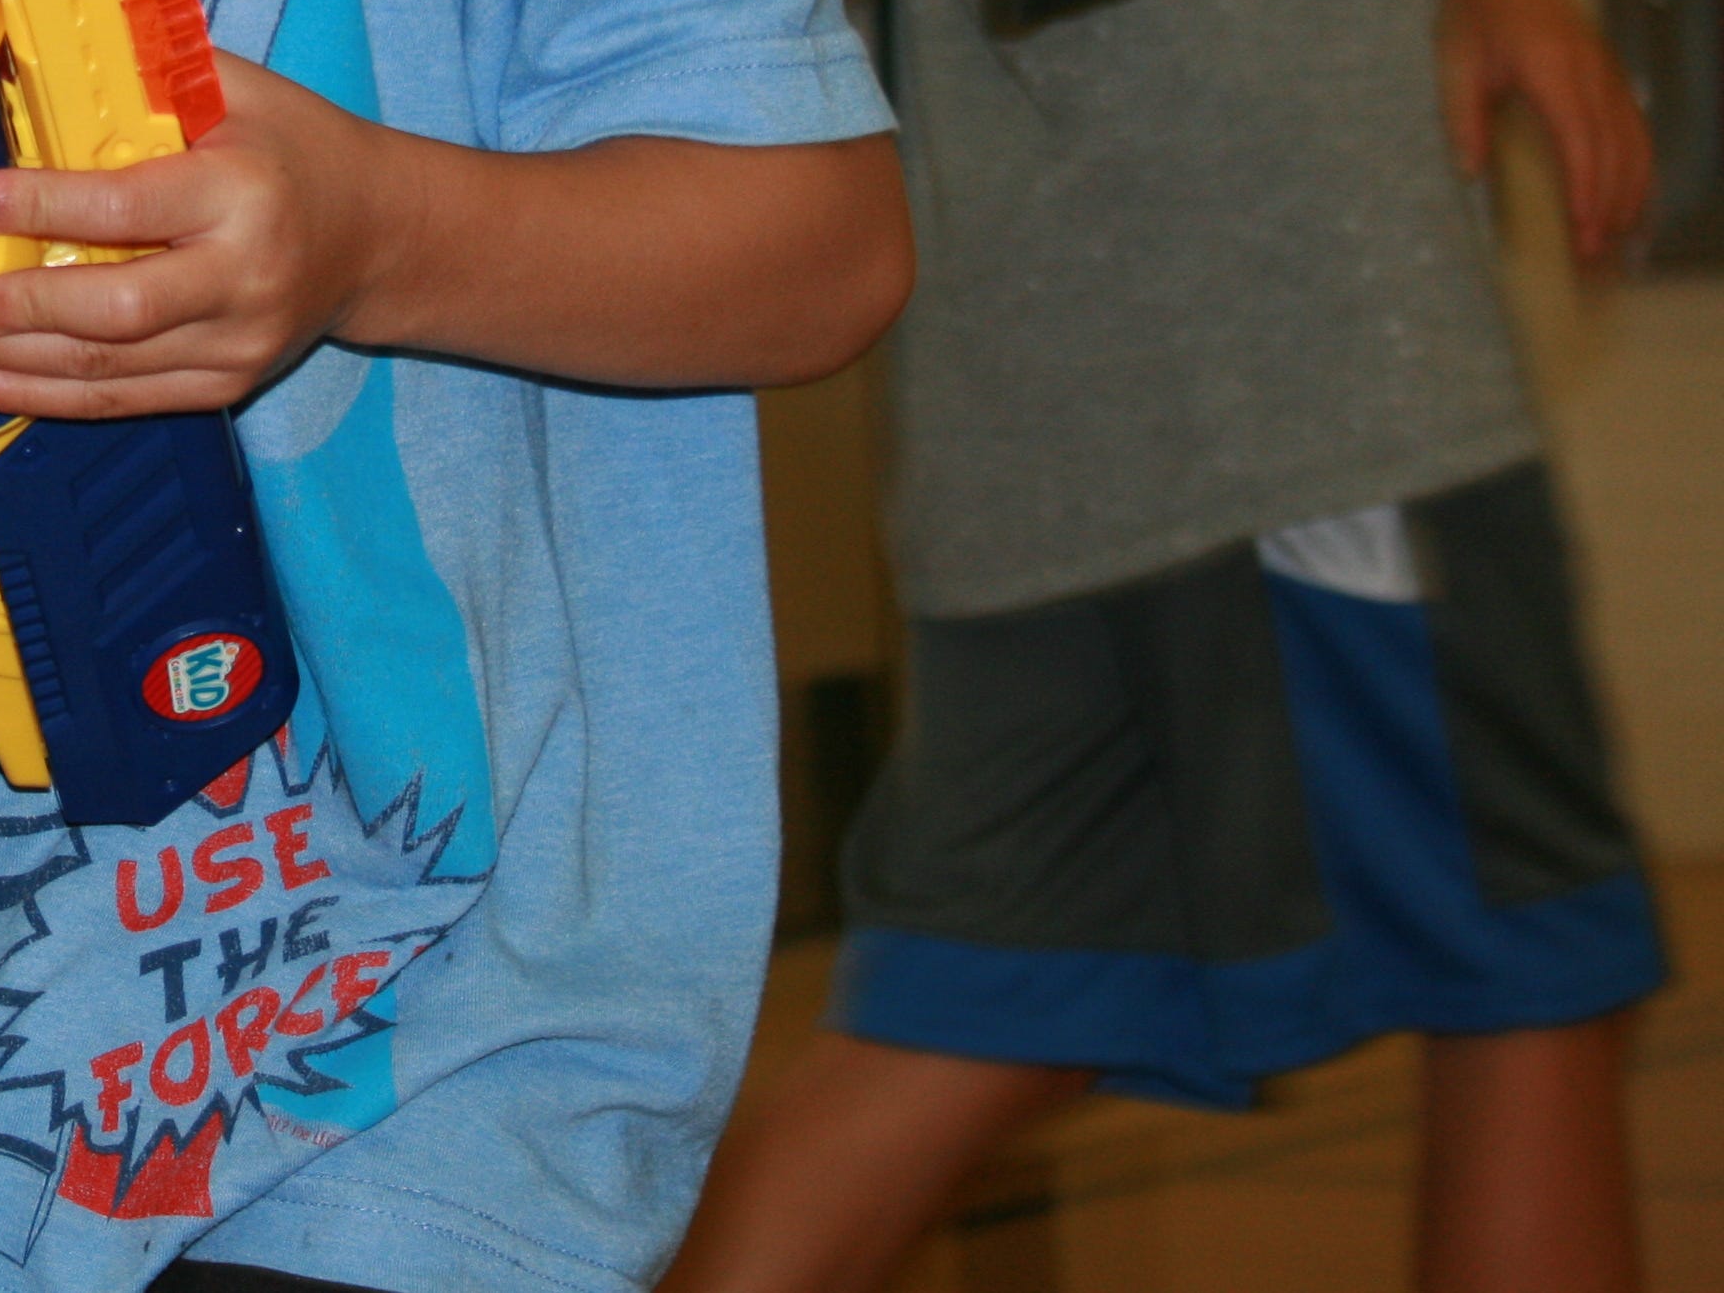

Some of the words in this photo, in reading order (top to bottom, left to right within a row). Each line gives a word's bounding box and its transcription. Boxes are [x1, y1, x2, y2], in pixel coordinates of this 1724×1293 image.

[186, 645, 226, 708] KID
[115, 803, 332, 933] USE
[140, 895, 340, 1024] THE
[90, 950, 392, 1134] FORCE
